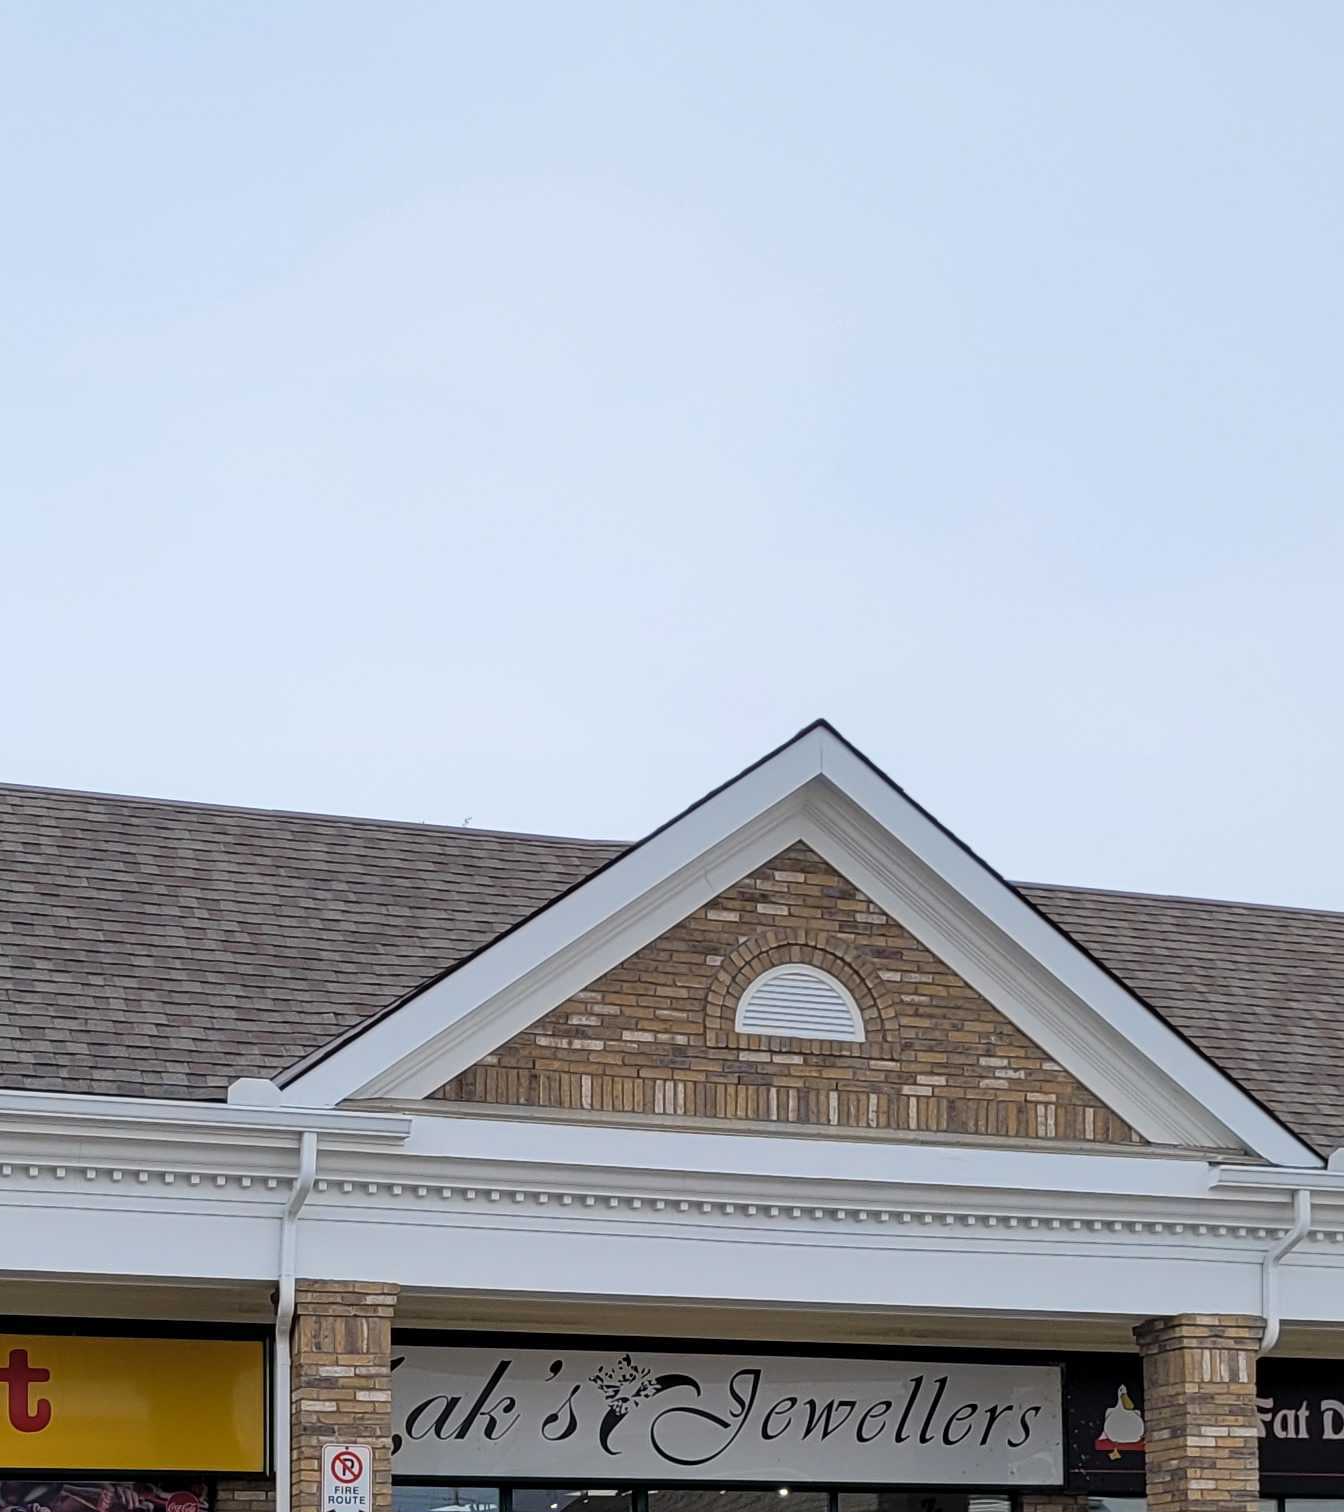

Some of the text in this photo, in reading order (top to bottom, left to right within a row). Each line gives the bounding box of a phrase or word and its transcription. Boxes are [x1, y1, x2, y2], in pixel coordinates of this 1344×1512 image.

[391, 1356, 1041, 1466] ak's Jewellers
[334, 1486, 360, 1495] FIRE
[327, 1495, 367, 1505] ROUTE
